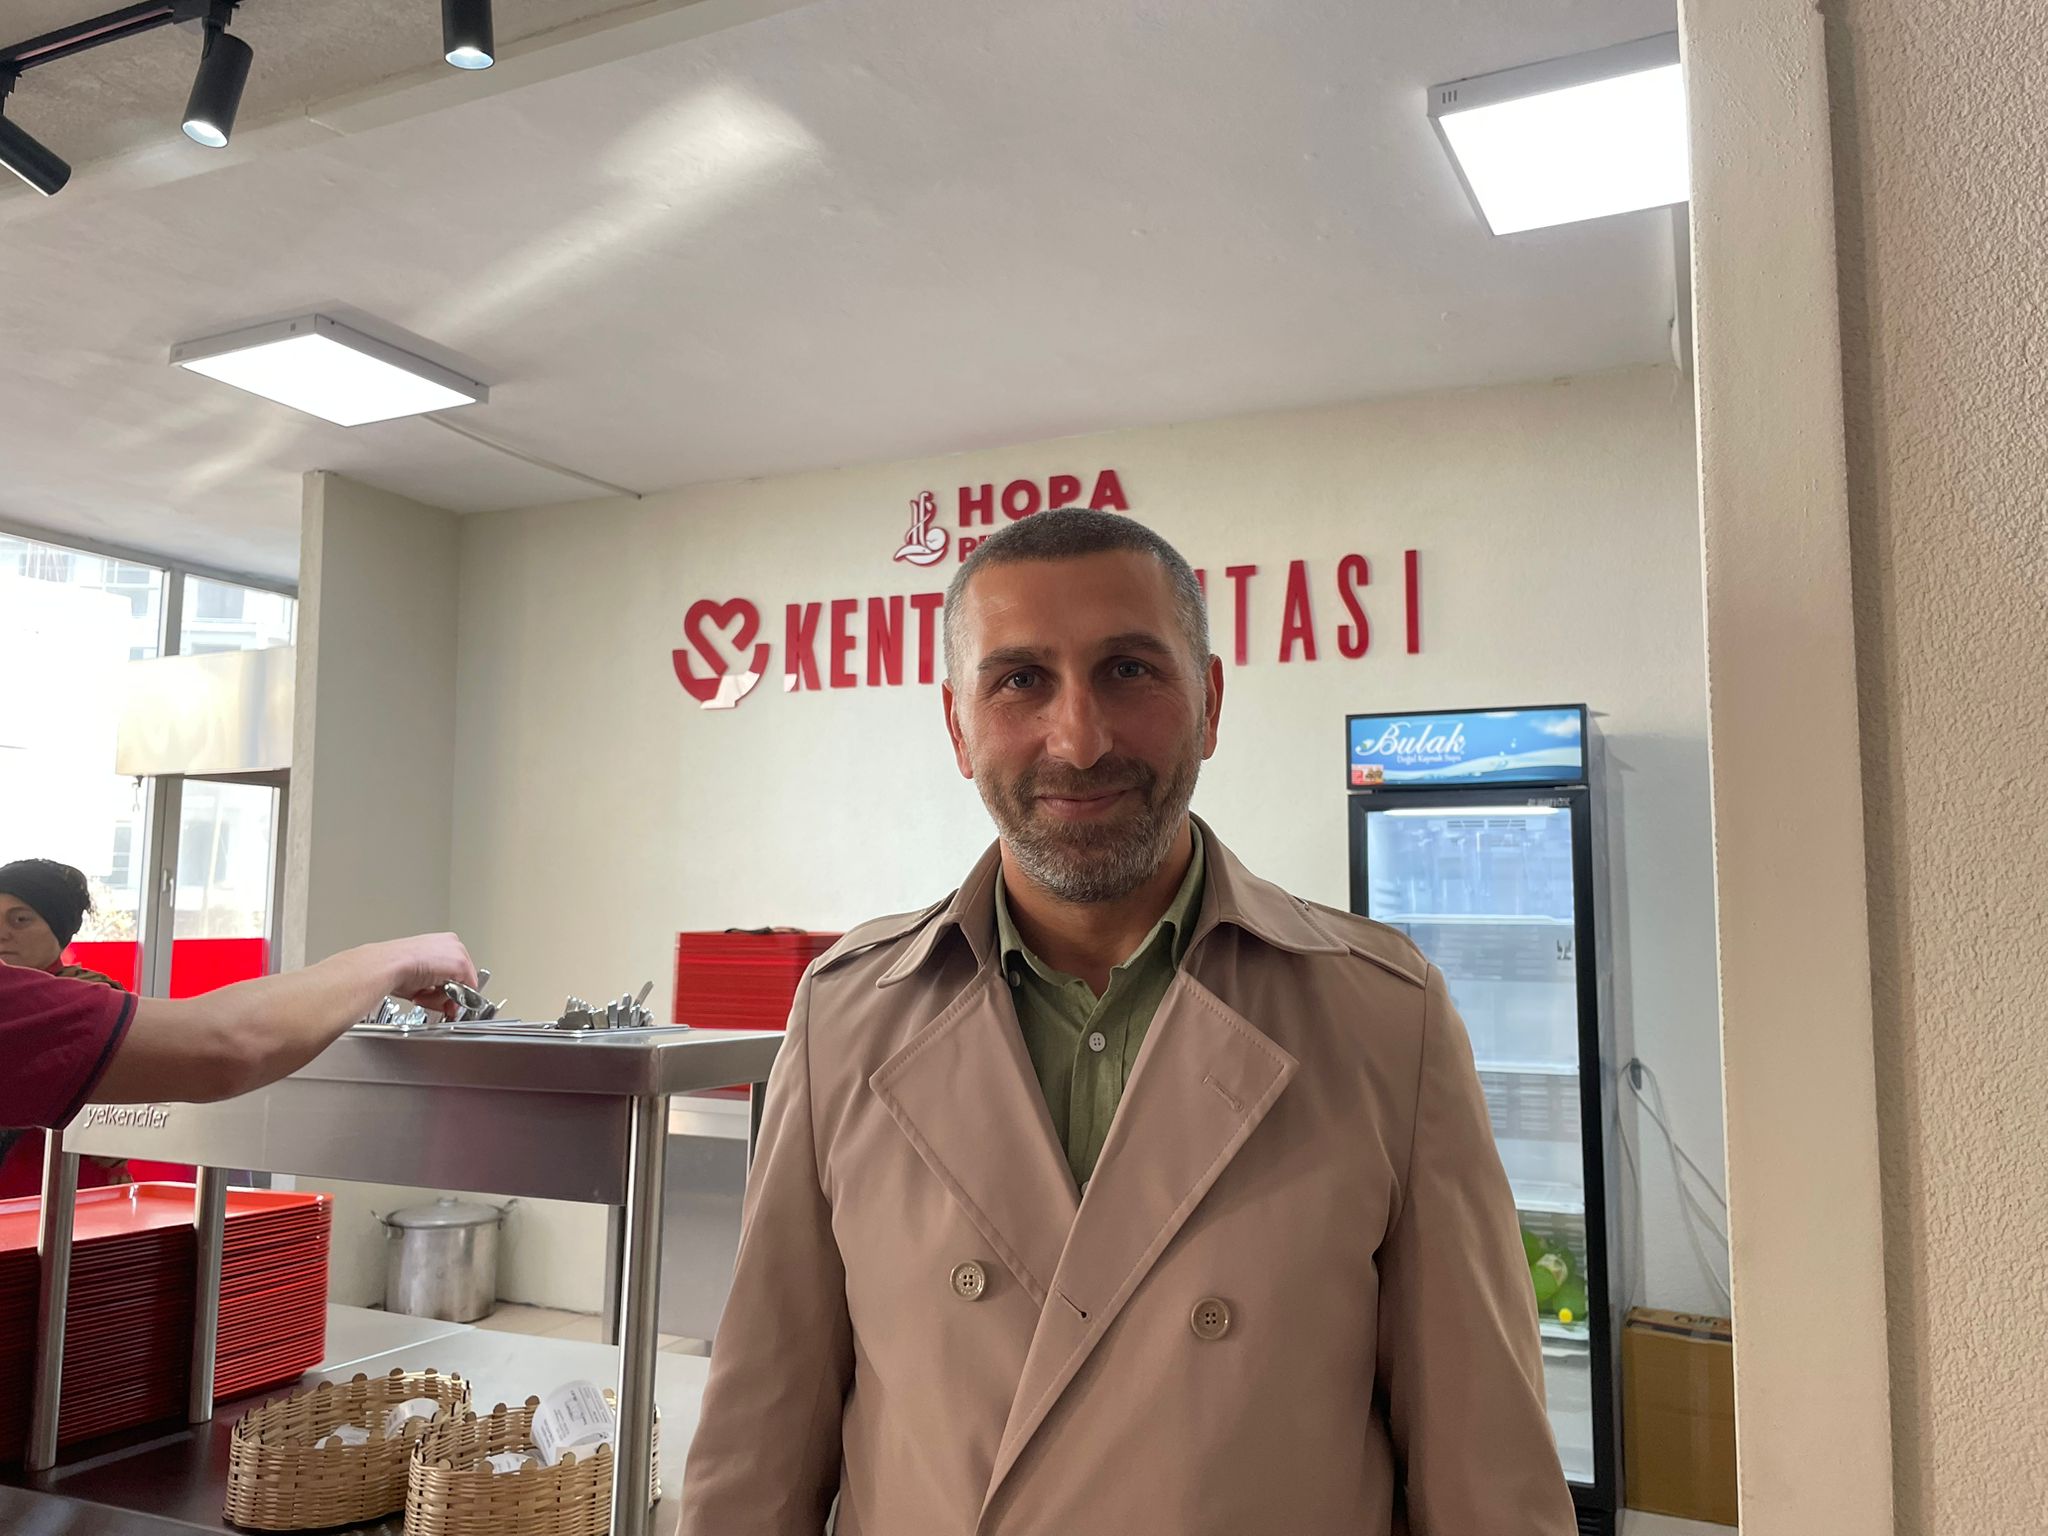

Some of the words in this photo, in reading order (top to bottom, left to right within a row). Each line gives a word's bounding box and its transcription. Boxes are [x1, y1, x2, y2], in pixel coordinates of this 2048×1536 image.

[958, 469, 1130, 528] HOPA
[784, 592, 945, 693] KENT
[1355, 721, 1465, 756] Bulak
[83, 1104, 170, 1129] yelkenciler
